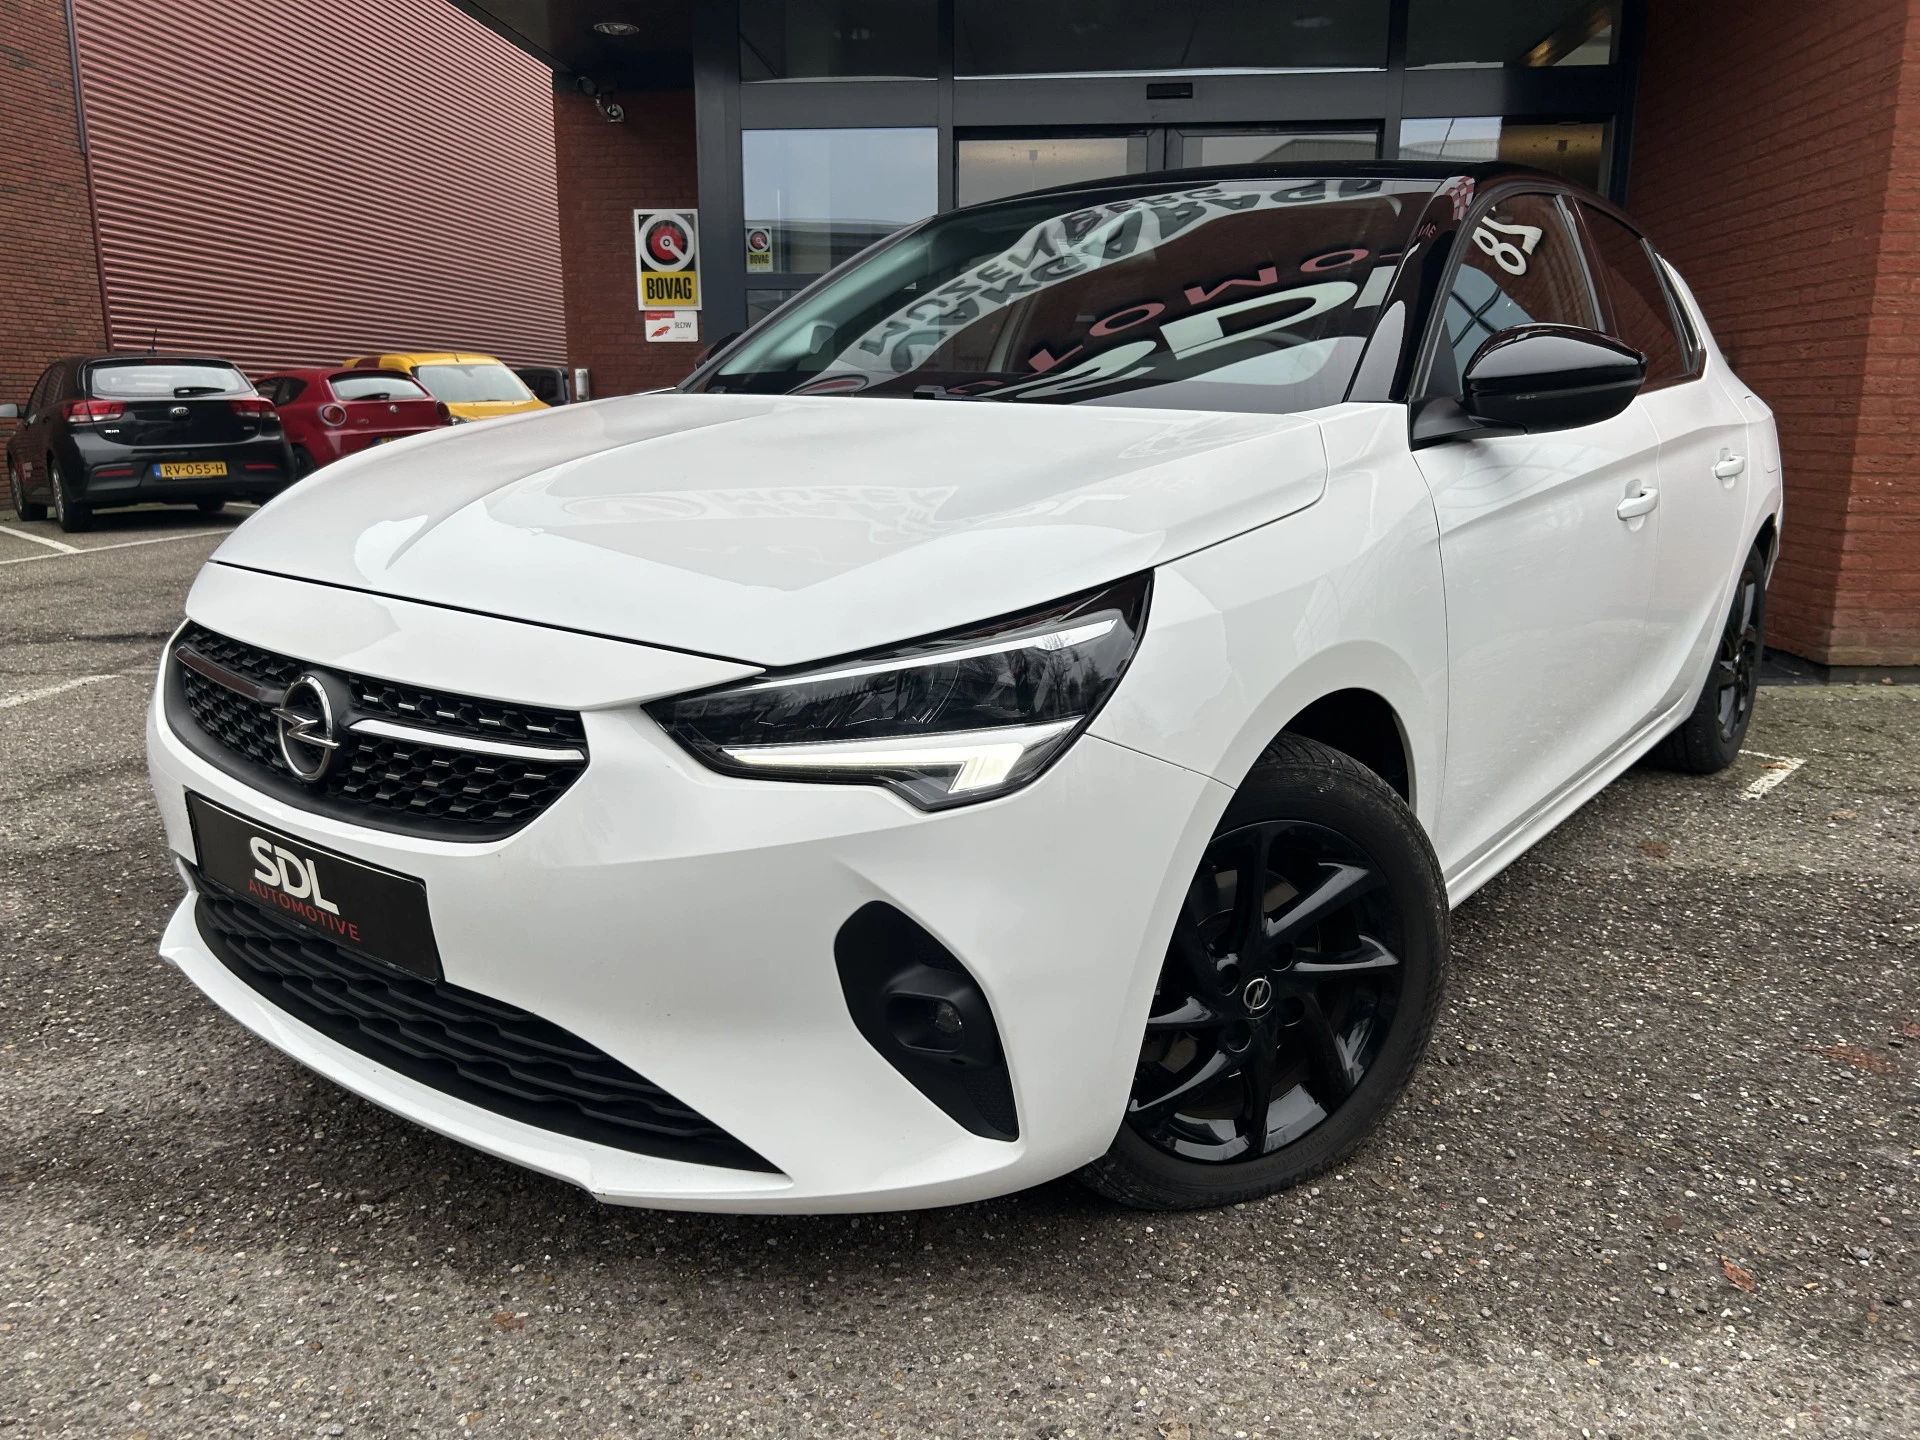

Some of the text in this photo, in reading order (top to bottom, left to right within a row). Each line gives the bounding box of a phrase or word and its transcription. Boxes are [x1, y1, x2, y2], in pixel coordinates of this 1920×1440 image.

[750, 254, 770, 265] BOVAG
[646, 277, 692, 300] BOVAG
[165, 463, 224, 476] RV-055-H
[250, 836, 340, 916] SDL
[249, 878, 361, 942] AUTOMOTIVE
